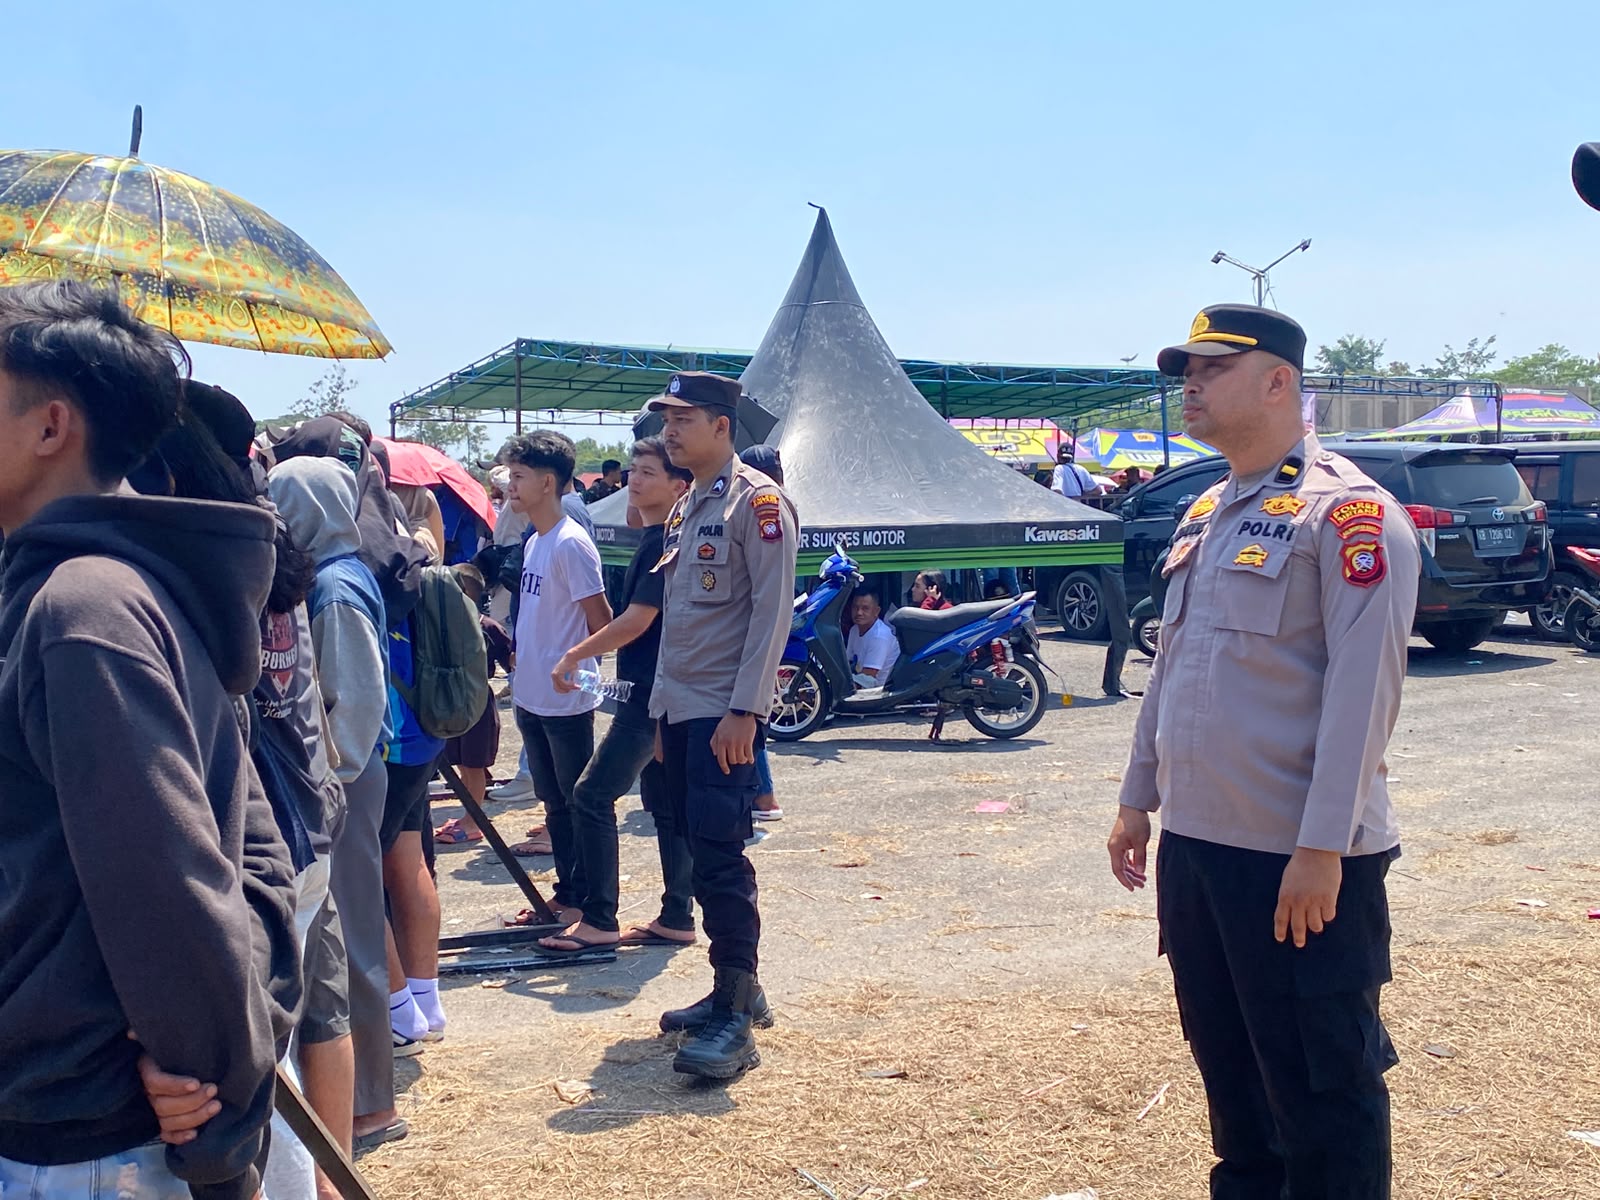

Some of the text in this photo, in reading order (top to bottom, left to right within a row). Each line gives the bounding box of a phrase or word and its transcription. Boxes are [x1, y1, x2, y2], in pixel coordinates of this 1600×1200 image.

[1332, 501, 1379, 519] POLRES
[595, 527, 616, 542] MOTOR
[697, 524, 723, 537] POLRI
[812, 530, 860, 548] SUKSES
[862, 529, 905, 546] MOTOR
[1024, 524, 1100, 542] Kawasaki
[1237, 520, 1296, 542] POLRI
